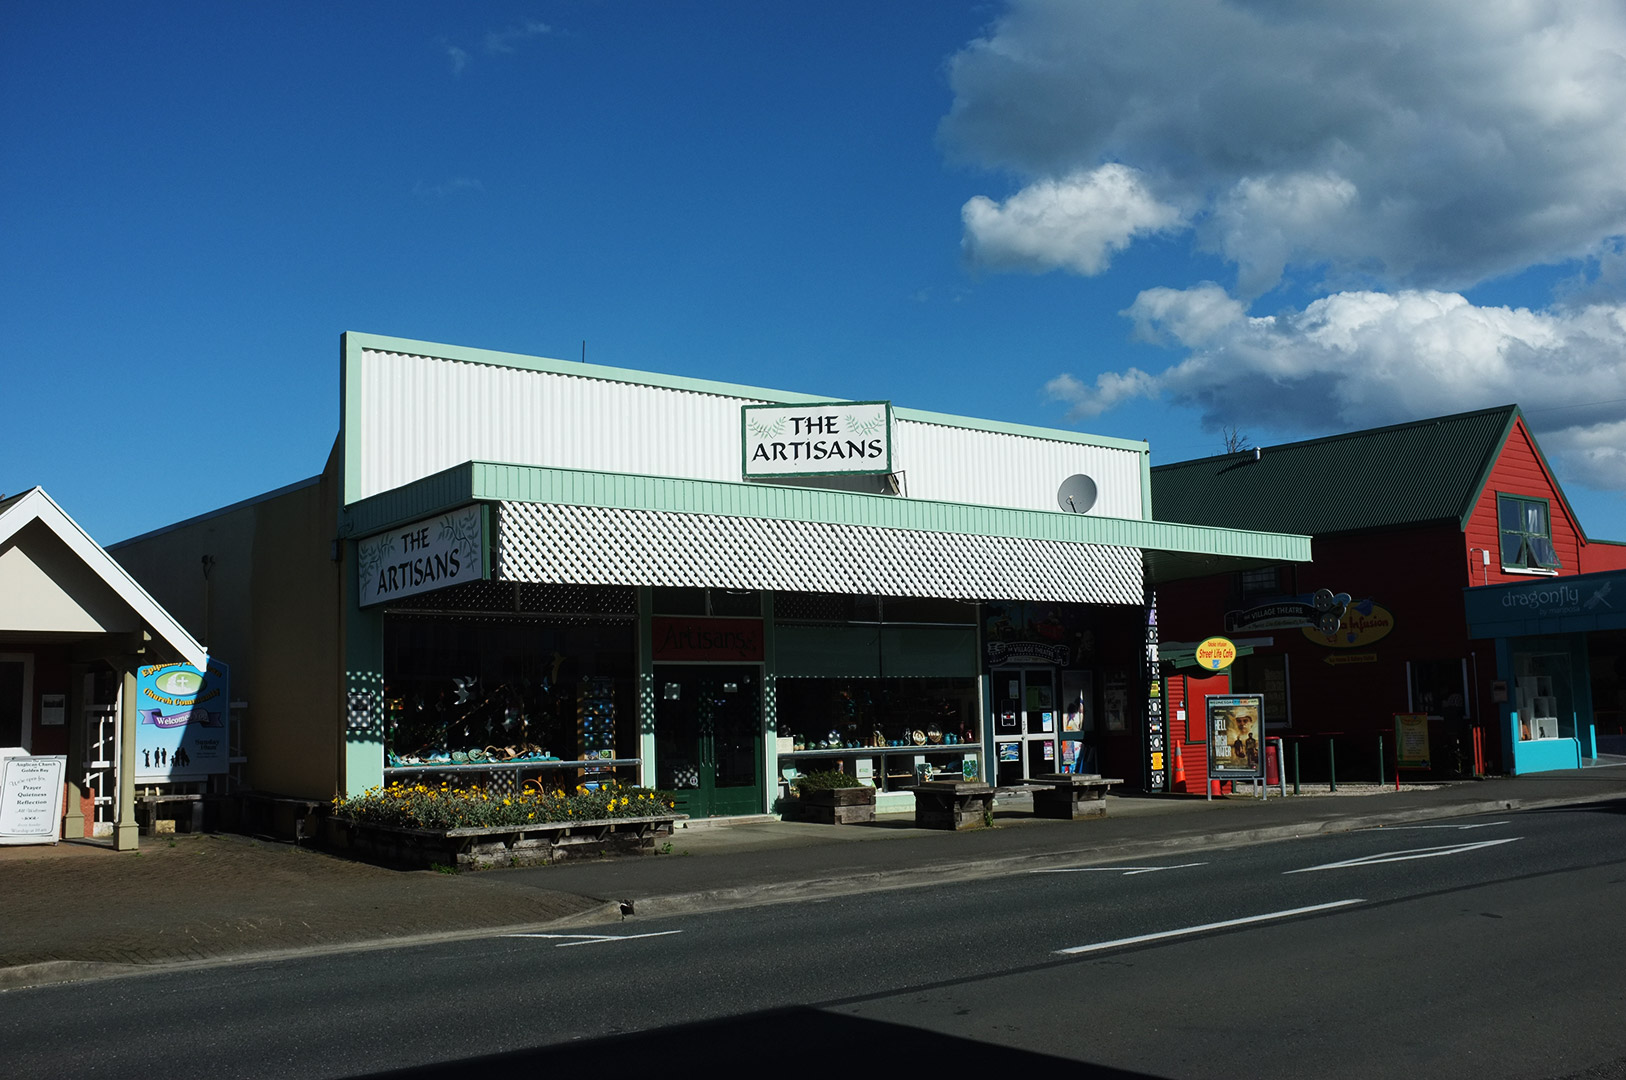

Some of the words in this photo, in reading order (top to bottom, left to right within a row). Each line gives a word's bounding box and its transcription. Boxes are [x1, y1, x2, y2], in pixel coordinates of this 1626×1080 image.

[789, 416, 840, 435] THE
[752, 439, 883, 461] ARTISANS
[401, 527, 430, 553] THE
[377, 548, 460, 595] ARTISANS
[1502, 585, 1579, 608] dragonfly
[1251, 608, 1276, 619] VILLAGE
[1277, 606, 1304, 615] THEATRE
[1349, 616, 1389, 633] Infusion
[656, 624, 746, 654] Artisans
[1199, 648, 1213, 658] Street
[143, 688, 173, 705] Church
[1214, 719, 1227, 731] HELL
[1215, 745, 1232, 757] WATER
